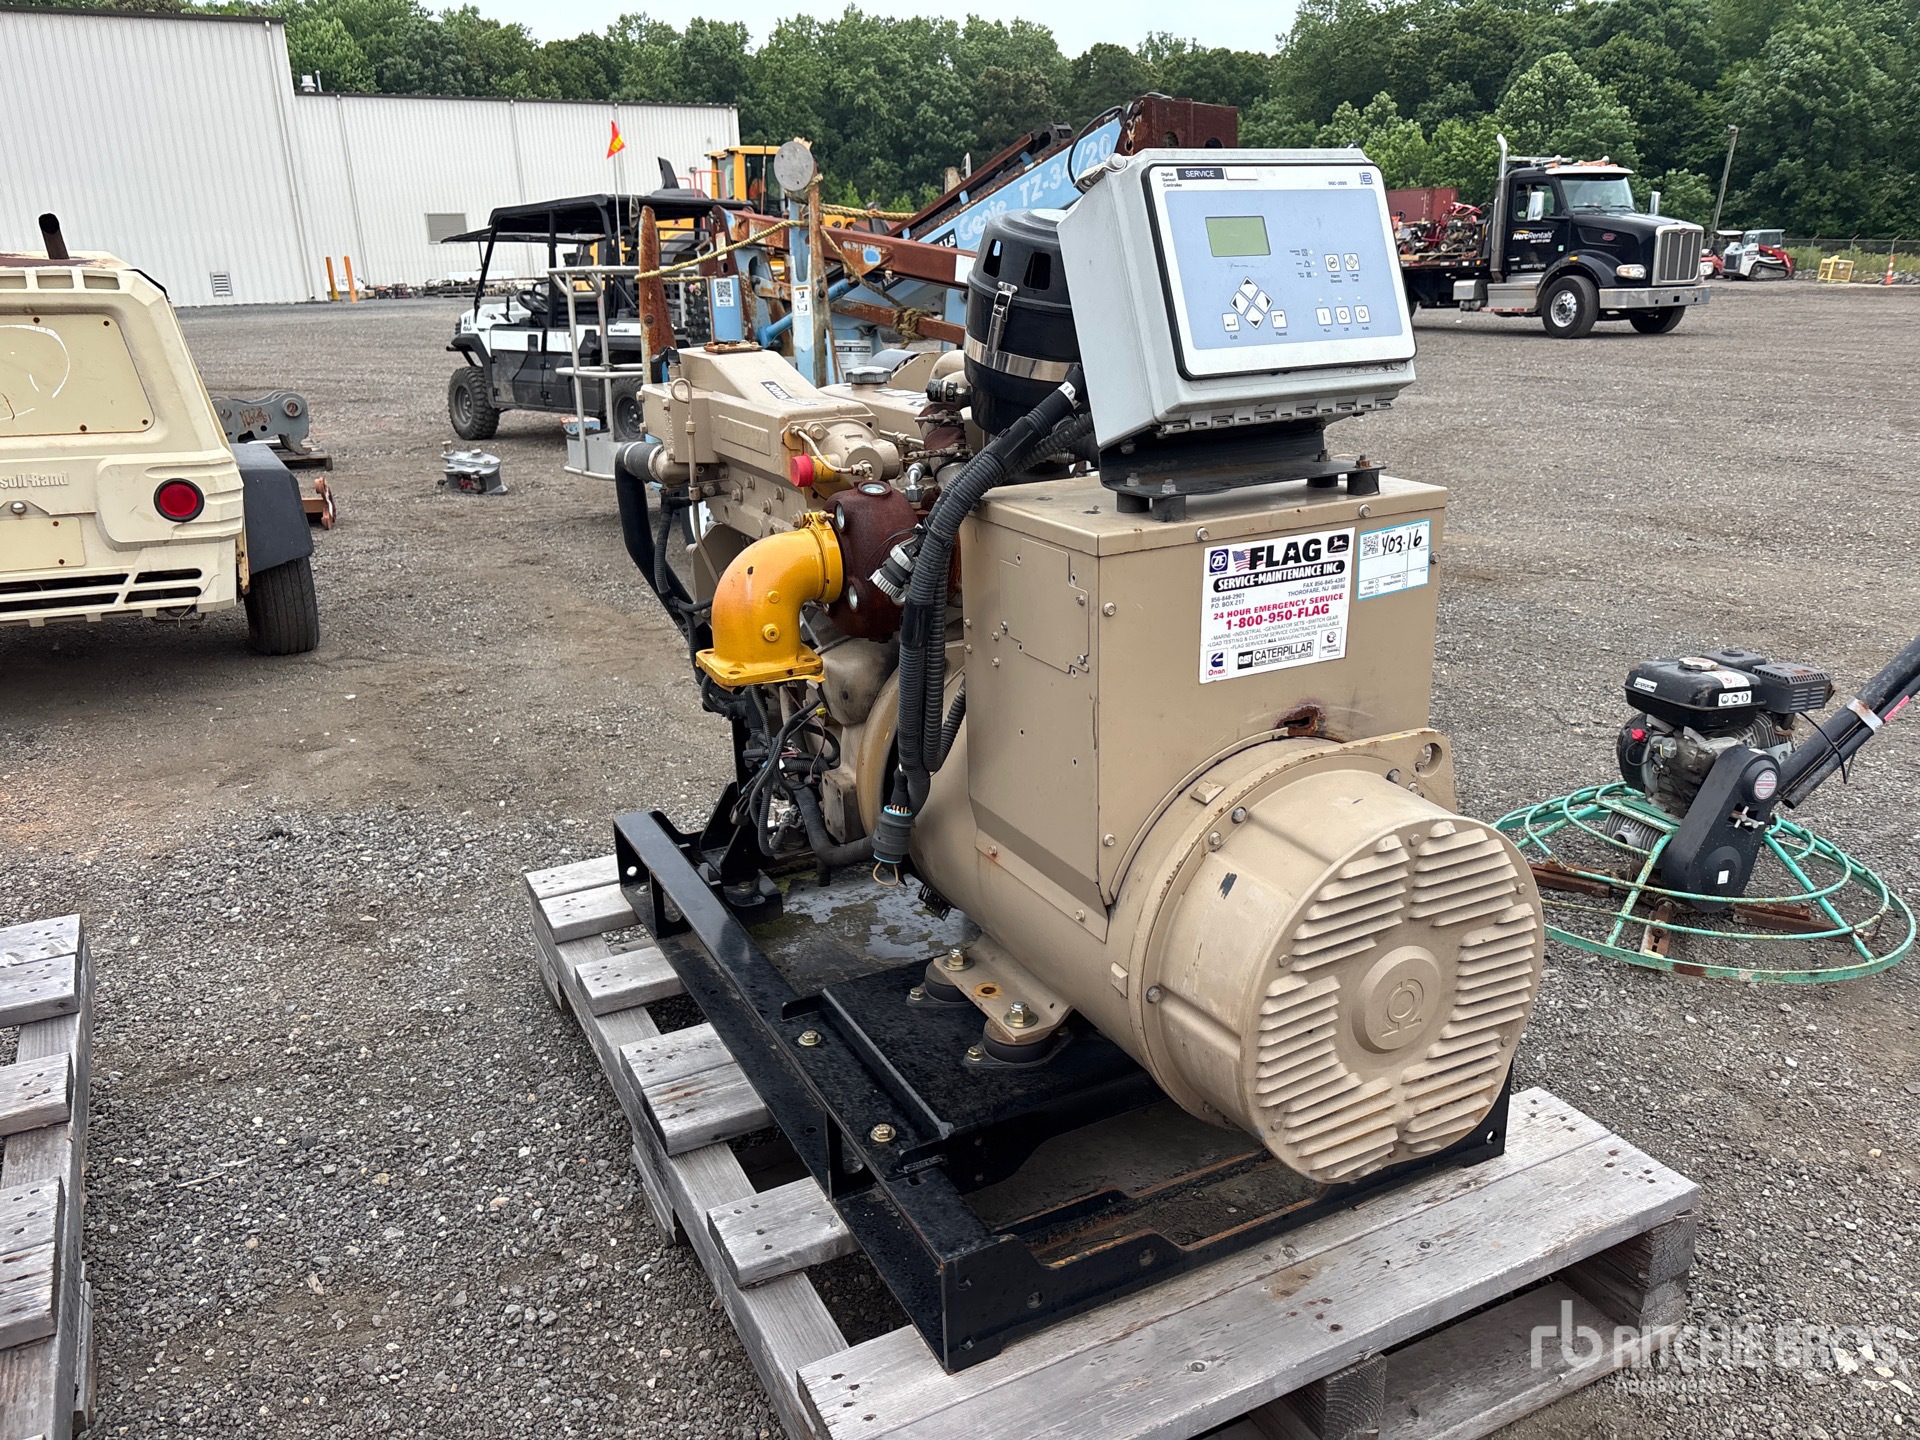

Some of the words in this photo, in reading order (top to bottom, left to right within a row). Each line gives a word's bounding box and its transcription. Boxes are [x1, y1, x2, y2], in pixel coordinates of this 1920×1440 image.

[1185, 170, 1216, 178] SERVICE
[1512, 231, 1553, 240] HercRentals
[1248, 538, 1322, 571] FLAG
[1217, 564, 1322, 591] SERVICE-MAINTENANCE
[1322, 562, 1341, 575] INC.
[1213, 612, 1224, 620] 24
[1227, 608, 1251, 618] HOUR
[1254, 599, 1307, 614] EMERGENCY
[1309, 593, 1344, 605] SERVICE
[1226, 603, 1330, 630] 1-800-950-FLAG
[1223, 637, 1243, 645] TESTING
[1248, 632, 1269, 640] CUSTOM
[1269, 629, 1288, 637] SERVICE
[1289, 625, 1317, 633] CONTRACTS
[1317, 620, 1340, 629] AVAILABLE
[1277, 630, 1318, 642] MANUFACTURERS
[1254, 641, 1312, 661] CATERPILLAR
[1208, 668, 1226, 676] Onan
